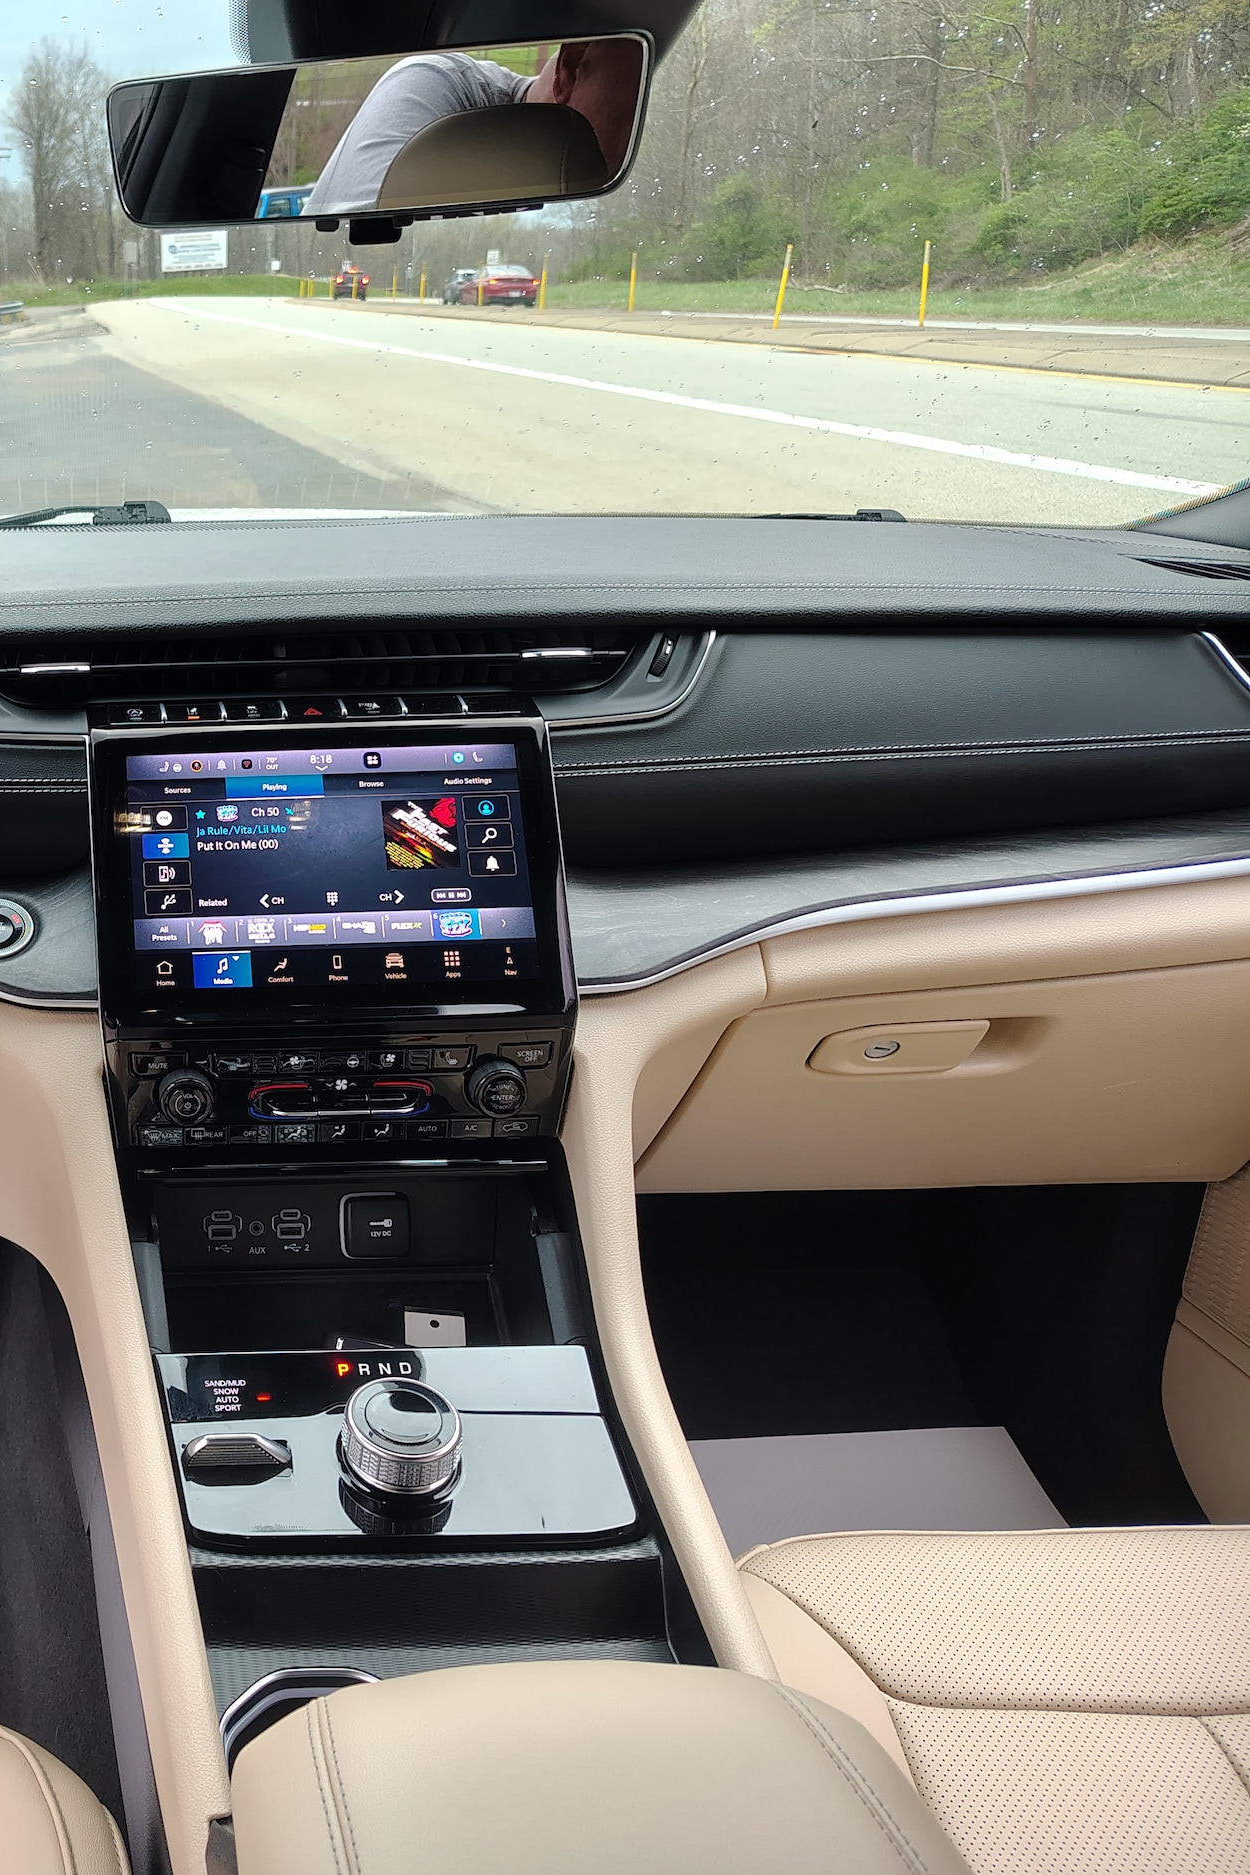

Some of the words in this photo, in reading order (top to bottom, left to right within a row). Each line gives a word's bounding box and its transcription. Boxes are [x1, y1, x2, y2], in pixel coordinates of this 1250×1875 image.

[266, 756, 278, 764] 70°
[309, 754, 333, 765] 8:18
[359, 780, 384, 788] Browse
[444, 777, 464, 785] Audio
[464, 776, 492, 786] Settings
[164, 786, 192, 795] Sources
[262, 783, 288, 792] Playing
[251, 807, 266, 817] Ch
[267, 807, 280, 817] 50
[196, 827, 206, 838] Ja
[207, 825, 270, 837] Rule/Vita/Lil
[271, 824, 287, 834] Mo
[197, 841, 214, 851] Put
[215, 841, 224, 850] It
[224, 841, 240, 850] On
[241, 840, 257, 850] Me
[258, 838, 279, 850] (00)
[271, 896, 285, 905] CH
[379, 892, 393, 901] CH
[198, 899, 228, 907] Related
[433, 912, 439, 920] 6
[159, 926, 169, 934] All
[247, 923, 275, 934] ROCK
[151, 934, 178, 942] Presets
[328, 974, 348, 982] Phone
[384, 972, 407, 980] Vehicle
[445, 971, 462, 979] Apps
[268, 975, 294, 984] Comfort
[516, 1050, 544, 1058] SCREEN
[148, 1062, 169, 1070] MUTE
[464, 1124, 478, 1132] A/C
[243, 1130, 257, 1138] OFF
[382, 1230, 392, 1238] DC
[207, 1245, 211, 1253] 1
[249, 1246, 267, 1255] AUX
[304, 1243, 310, 1252] 2
[337, 1363, 350, 1377] P
[358, 1363, 371, 1376] R
[379, 1362, 392, 1375] N
[400, 1361, 413, 1375] D
[204, 1379, 246, 1387] SAND/MUD
